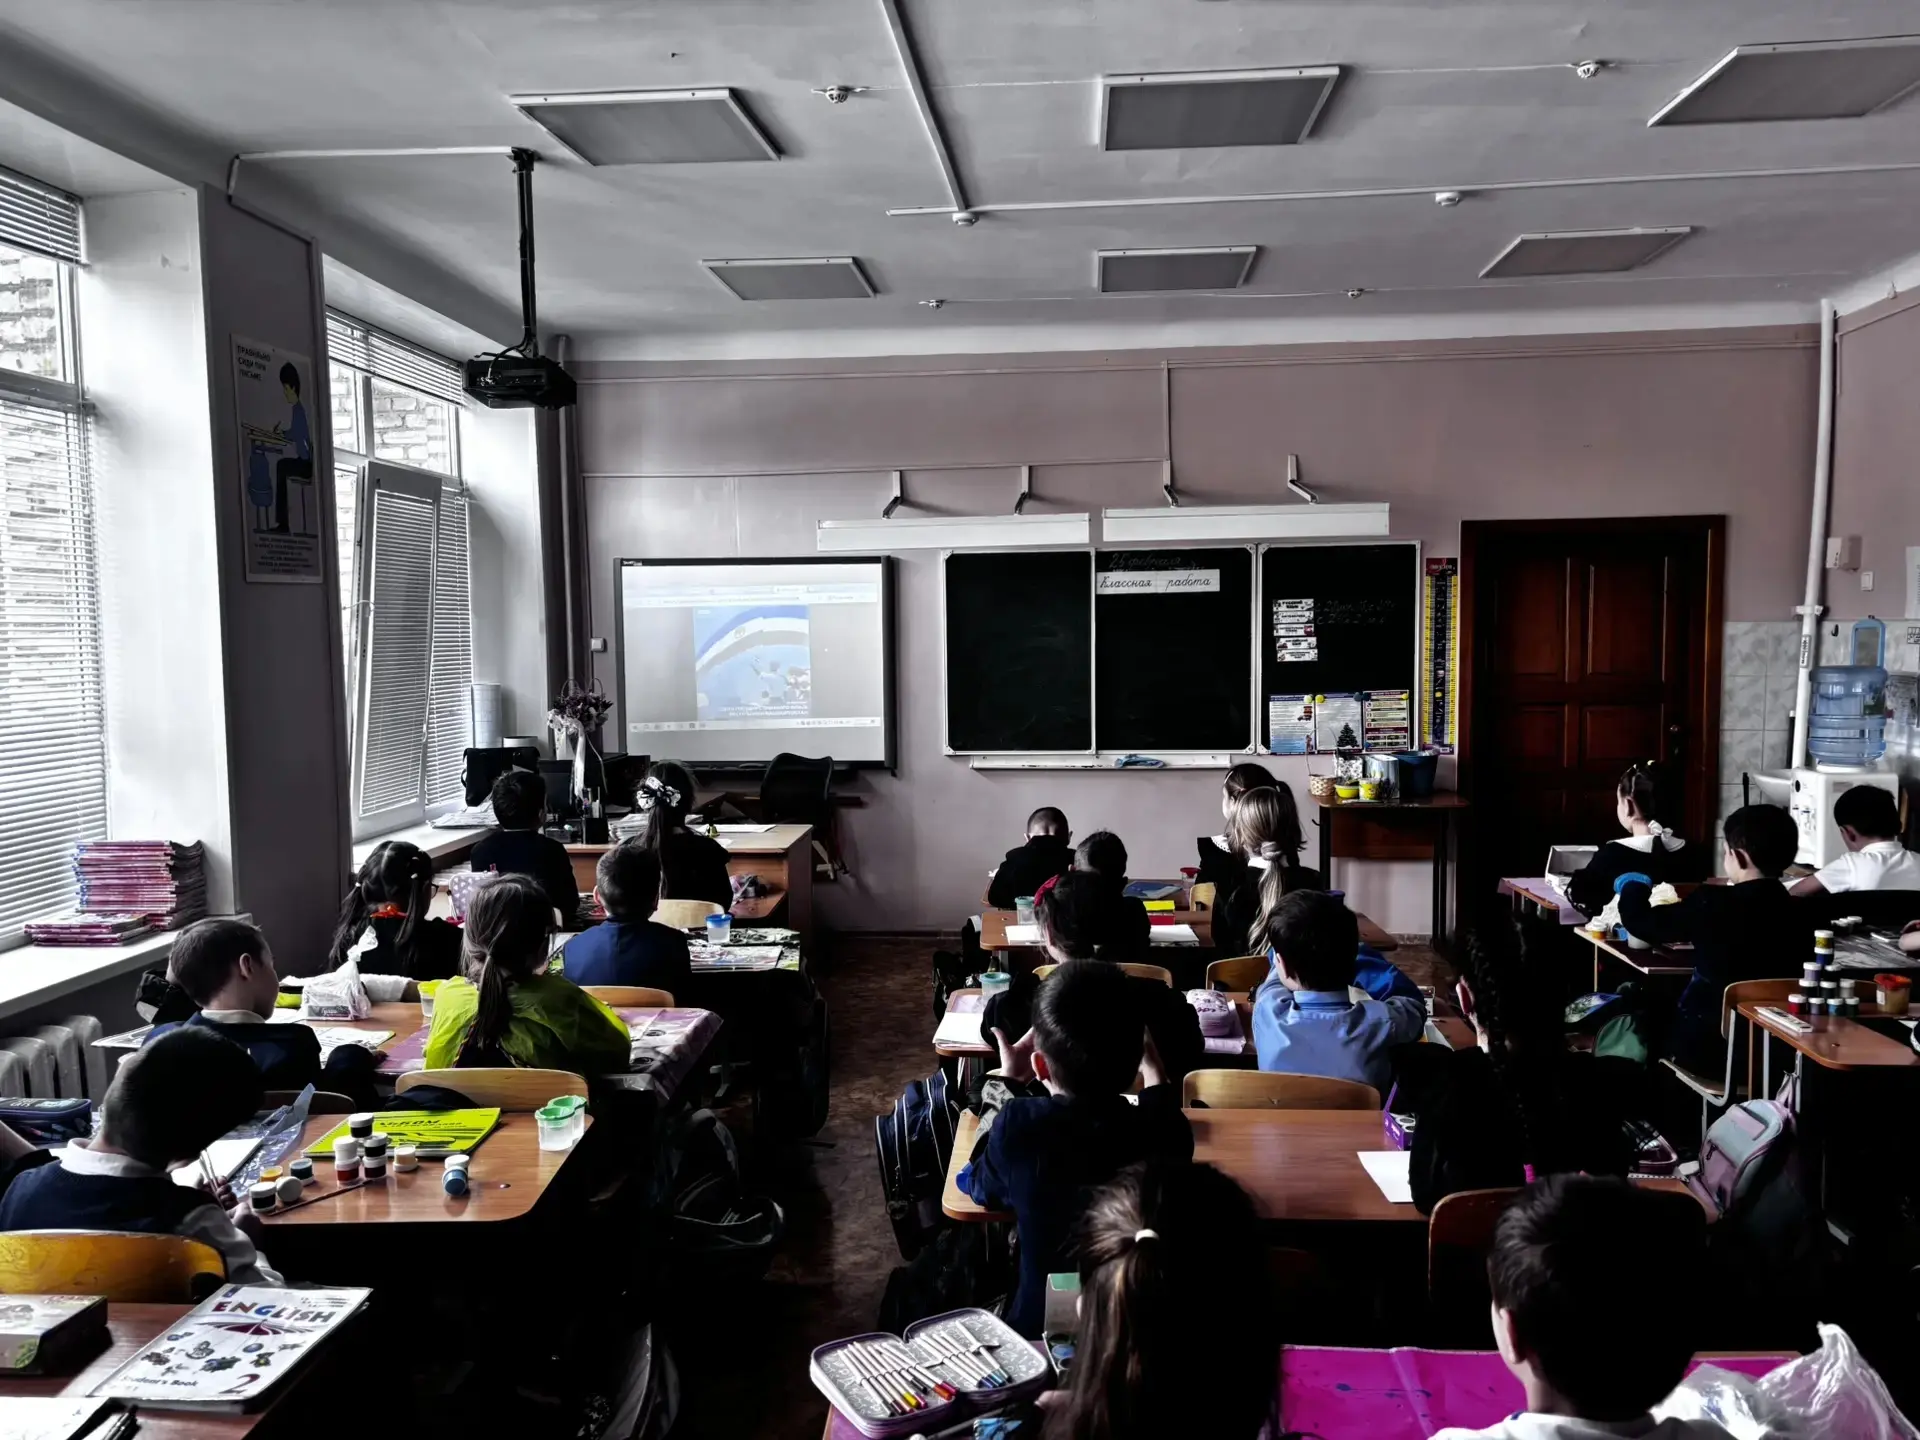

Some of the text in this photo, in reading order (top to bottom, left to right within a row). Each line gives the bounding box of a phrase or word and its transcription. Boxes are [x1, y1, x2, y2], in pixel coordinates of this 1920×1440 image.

[1100, 573, 1211, 592] Классная работа
[212, 1301, 337, 1323] ENGLISH
[170, 1379, 199, 1387] Book
[218, 1373, 261, 1395] 2
